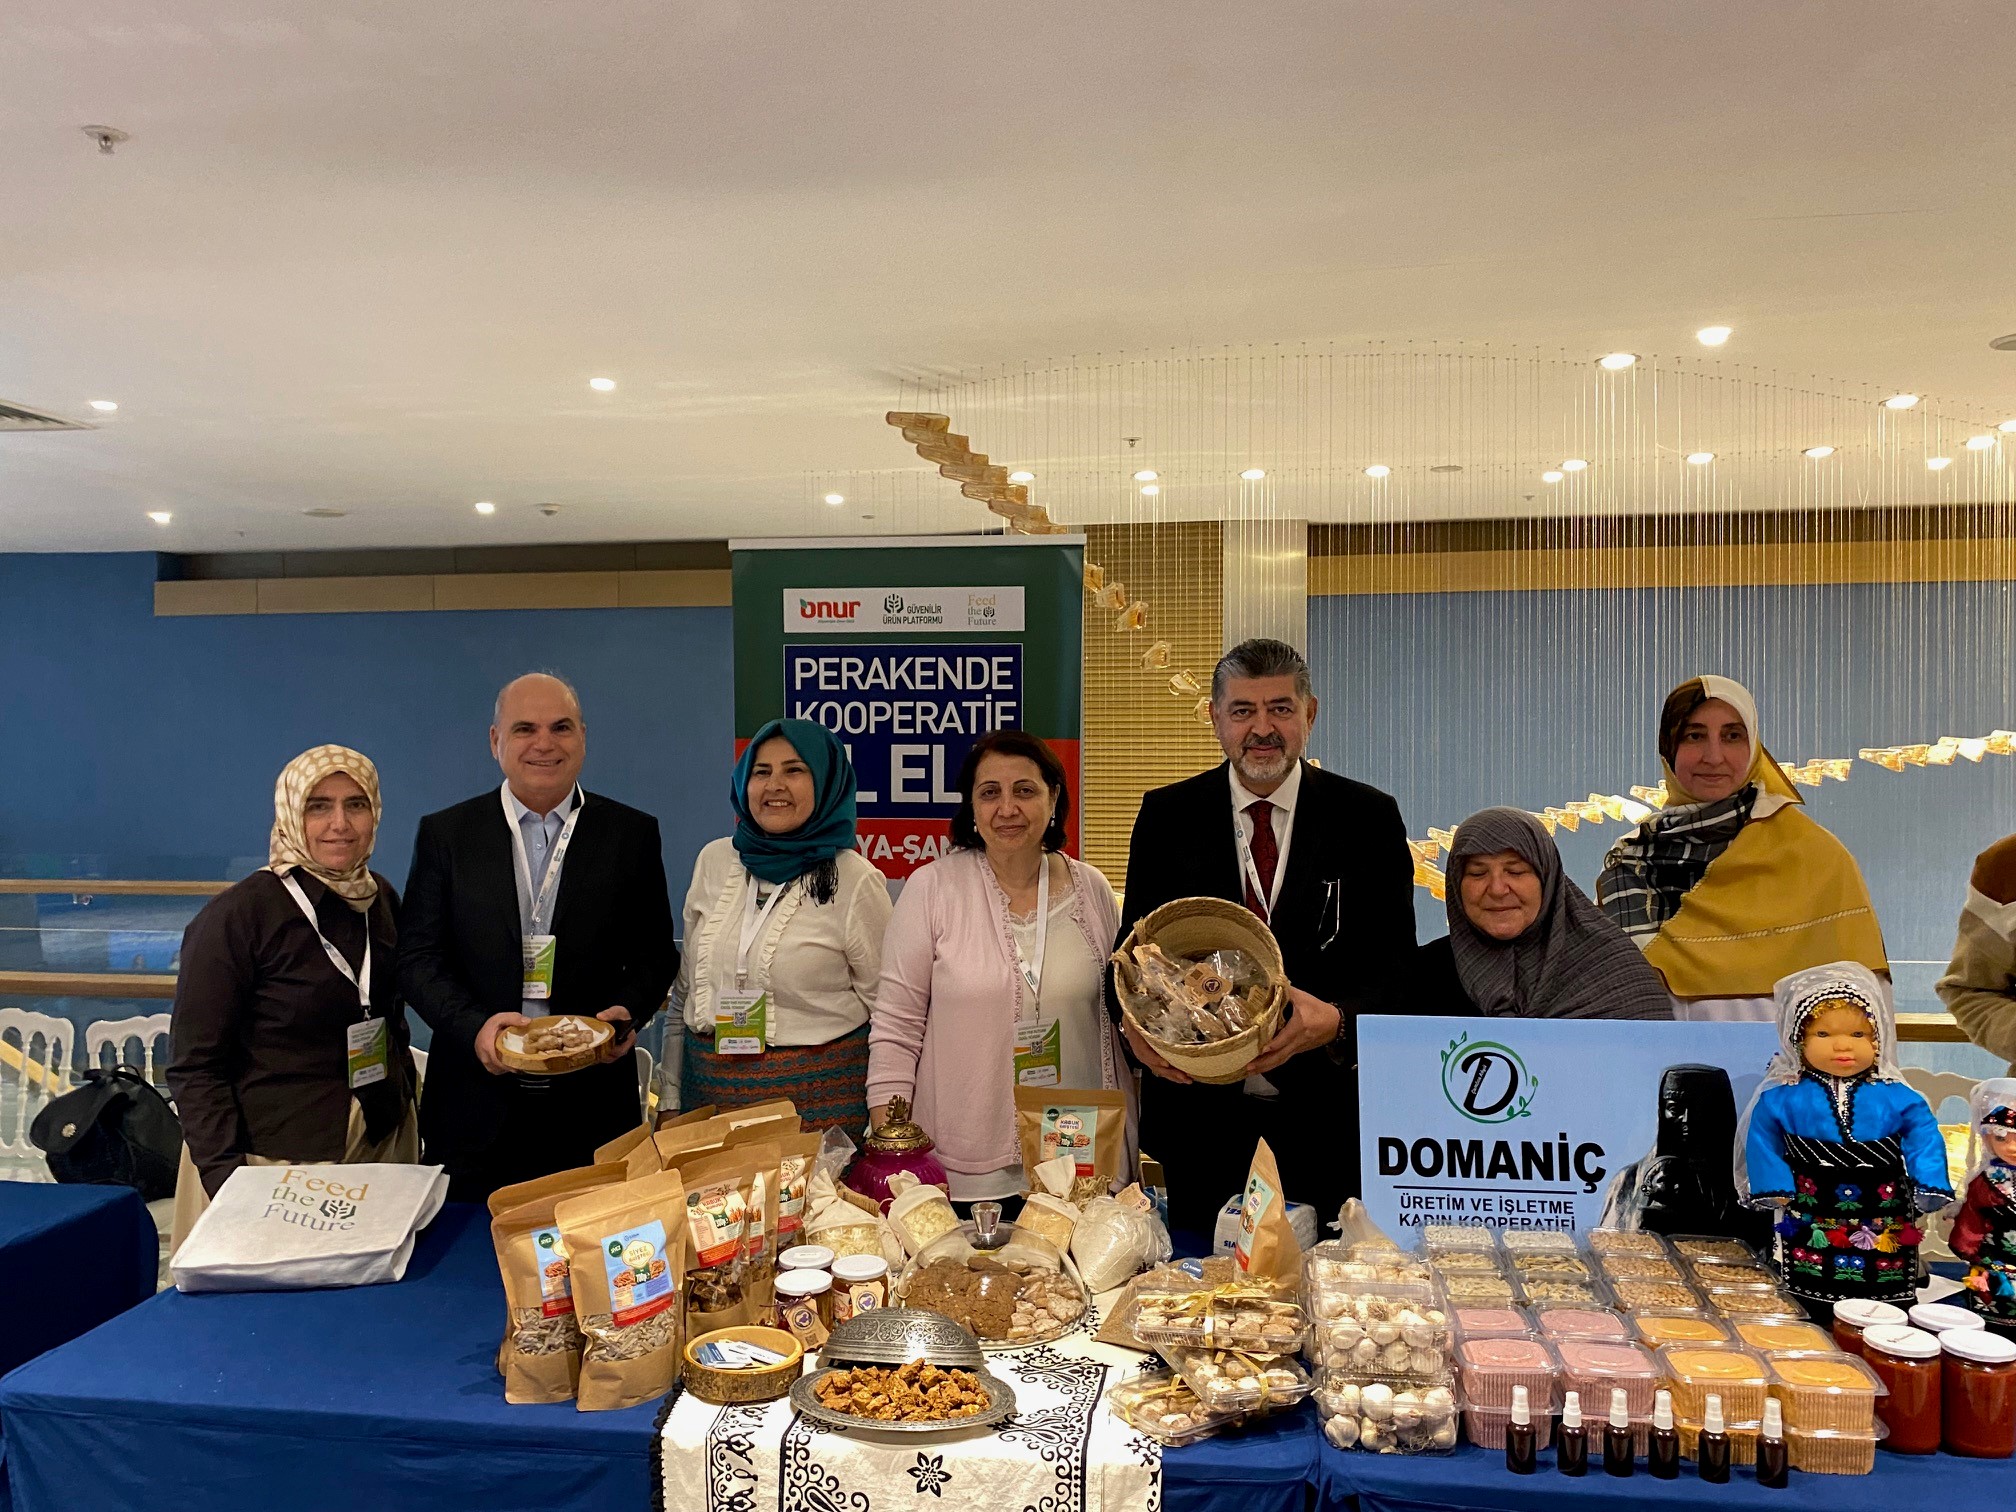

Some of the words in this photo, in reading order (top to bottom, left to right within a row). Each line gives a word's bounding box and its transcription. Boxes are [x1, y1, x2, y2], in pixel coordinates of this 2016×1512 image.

[906, 603, 942, 614] GÜVENİLİR
[967, 594, 996, 606] Feed
[882, 615, 902, 625] ÜRÜN
[902, 615, 943, 625] PLATFORMU
[967, 606, 982, 616] the
[967, 616, 997, 626] Future
[795, 656, 1014, 690] PERAKENDE
[1377, 1132, 1607, 1193] DOMANİÇ
[280, 1168, 369, 1201] Feed
[271, 1186, 315, 1207] the
[1400, 1193, 1465, 1211] ÜRETİM
[1470, 1197, 1493, 1212] VE
[1499, 1195, 1574, 1216] İŞLETME
[262, 1202, 356, 1232] Future
